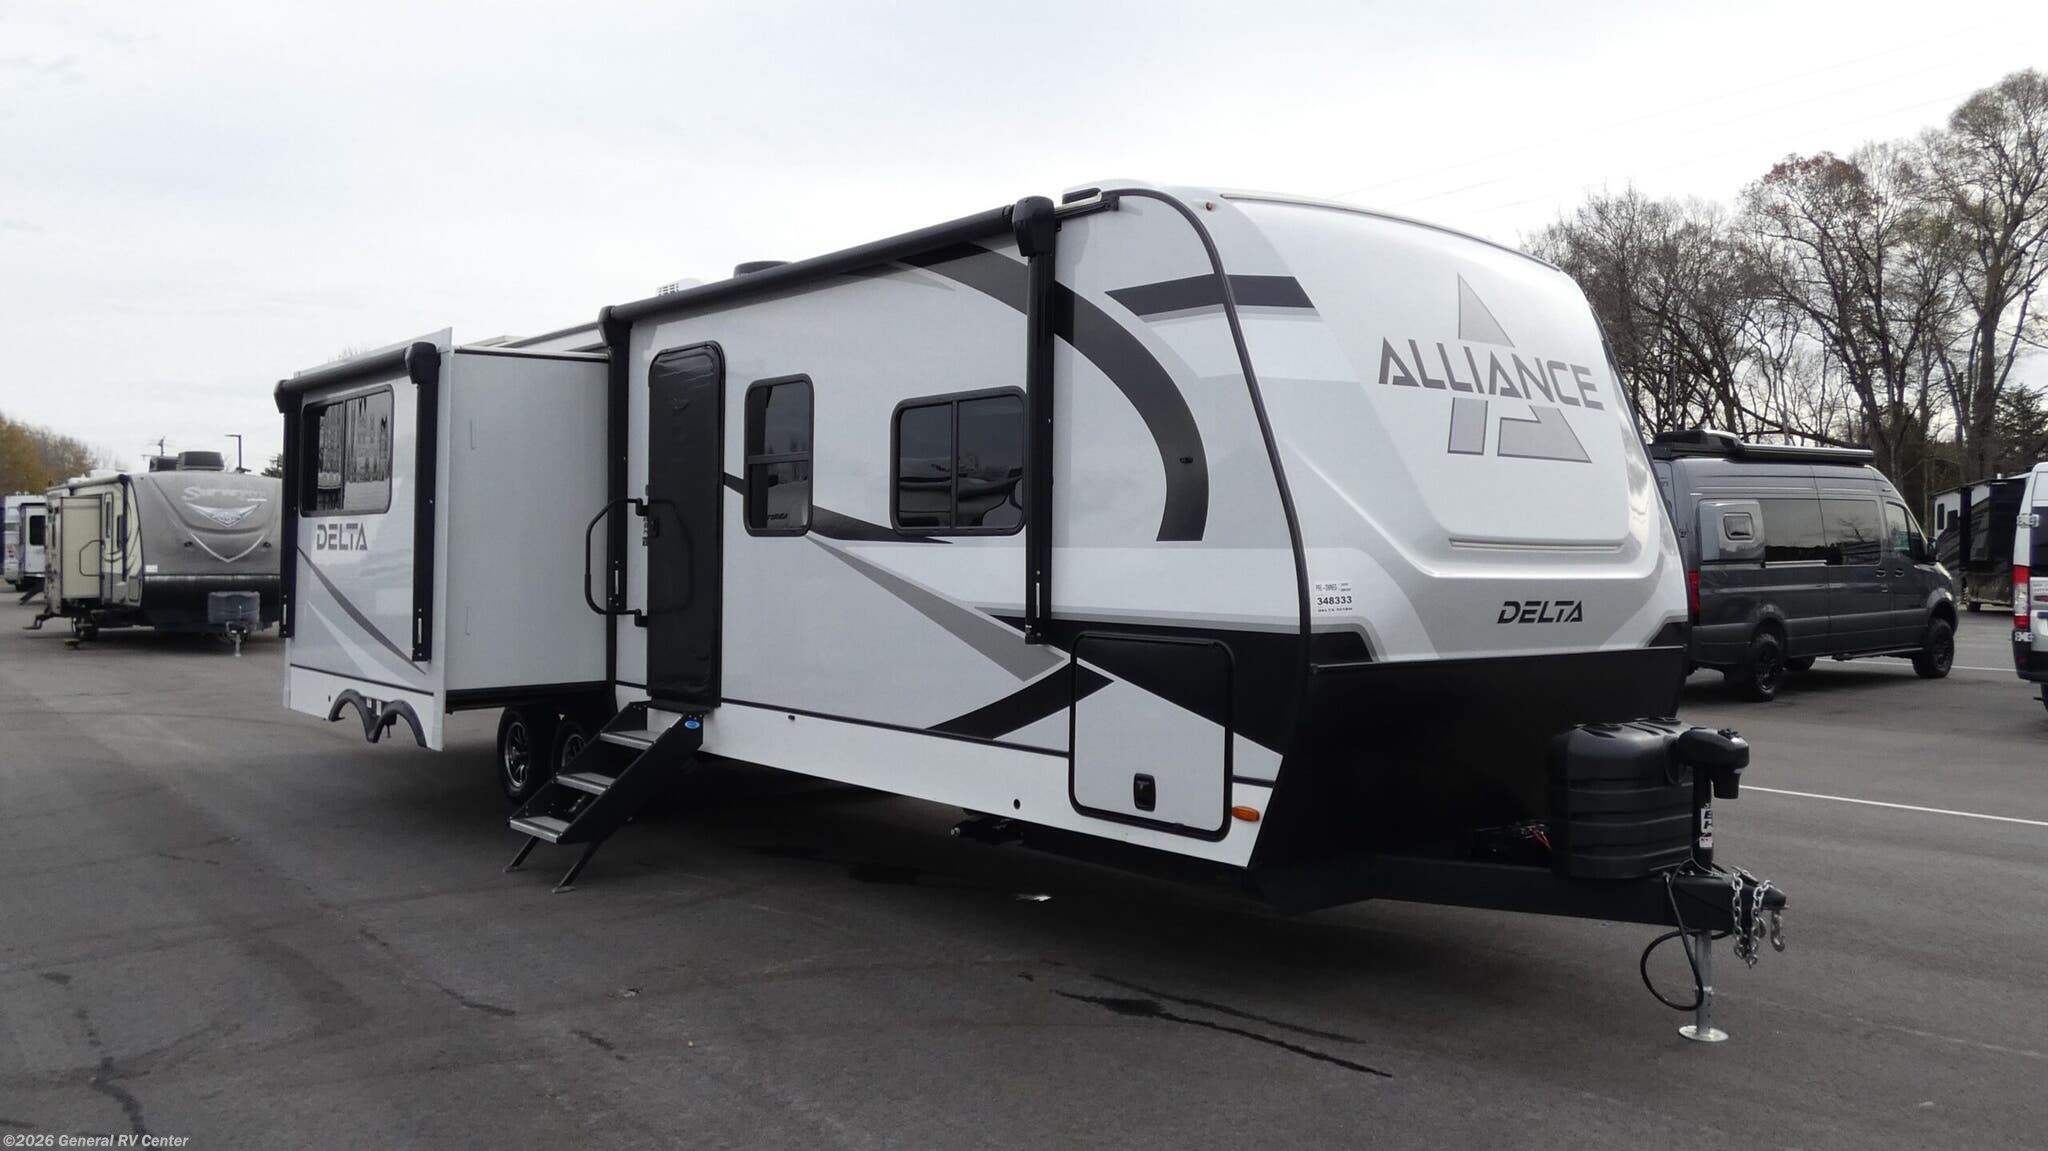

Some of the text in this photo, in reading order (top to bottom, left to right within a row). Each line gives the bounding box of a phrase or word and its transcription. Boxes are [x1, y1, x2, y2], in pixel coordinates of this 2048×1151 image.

[1379, 337, 1604, 411] ALLIANCE
[316, 523, 368, 551] DELTA
[1317, 596, 1352, 606] 348333
[1497, 600, 1583, 624] DELTA
